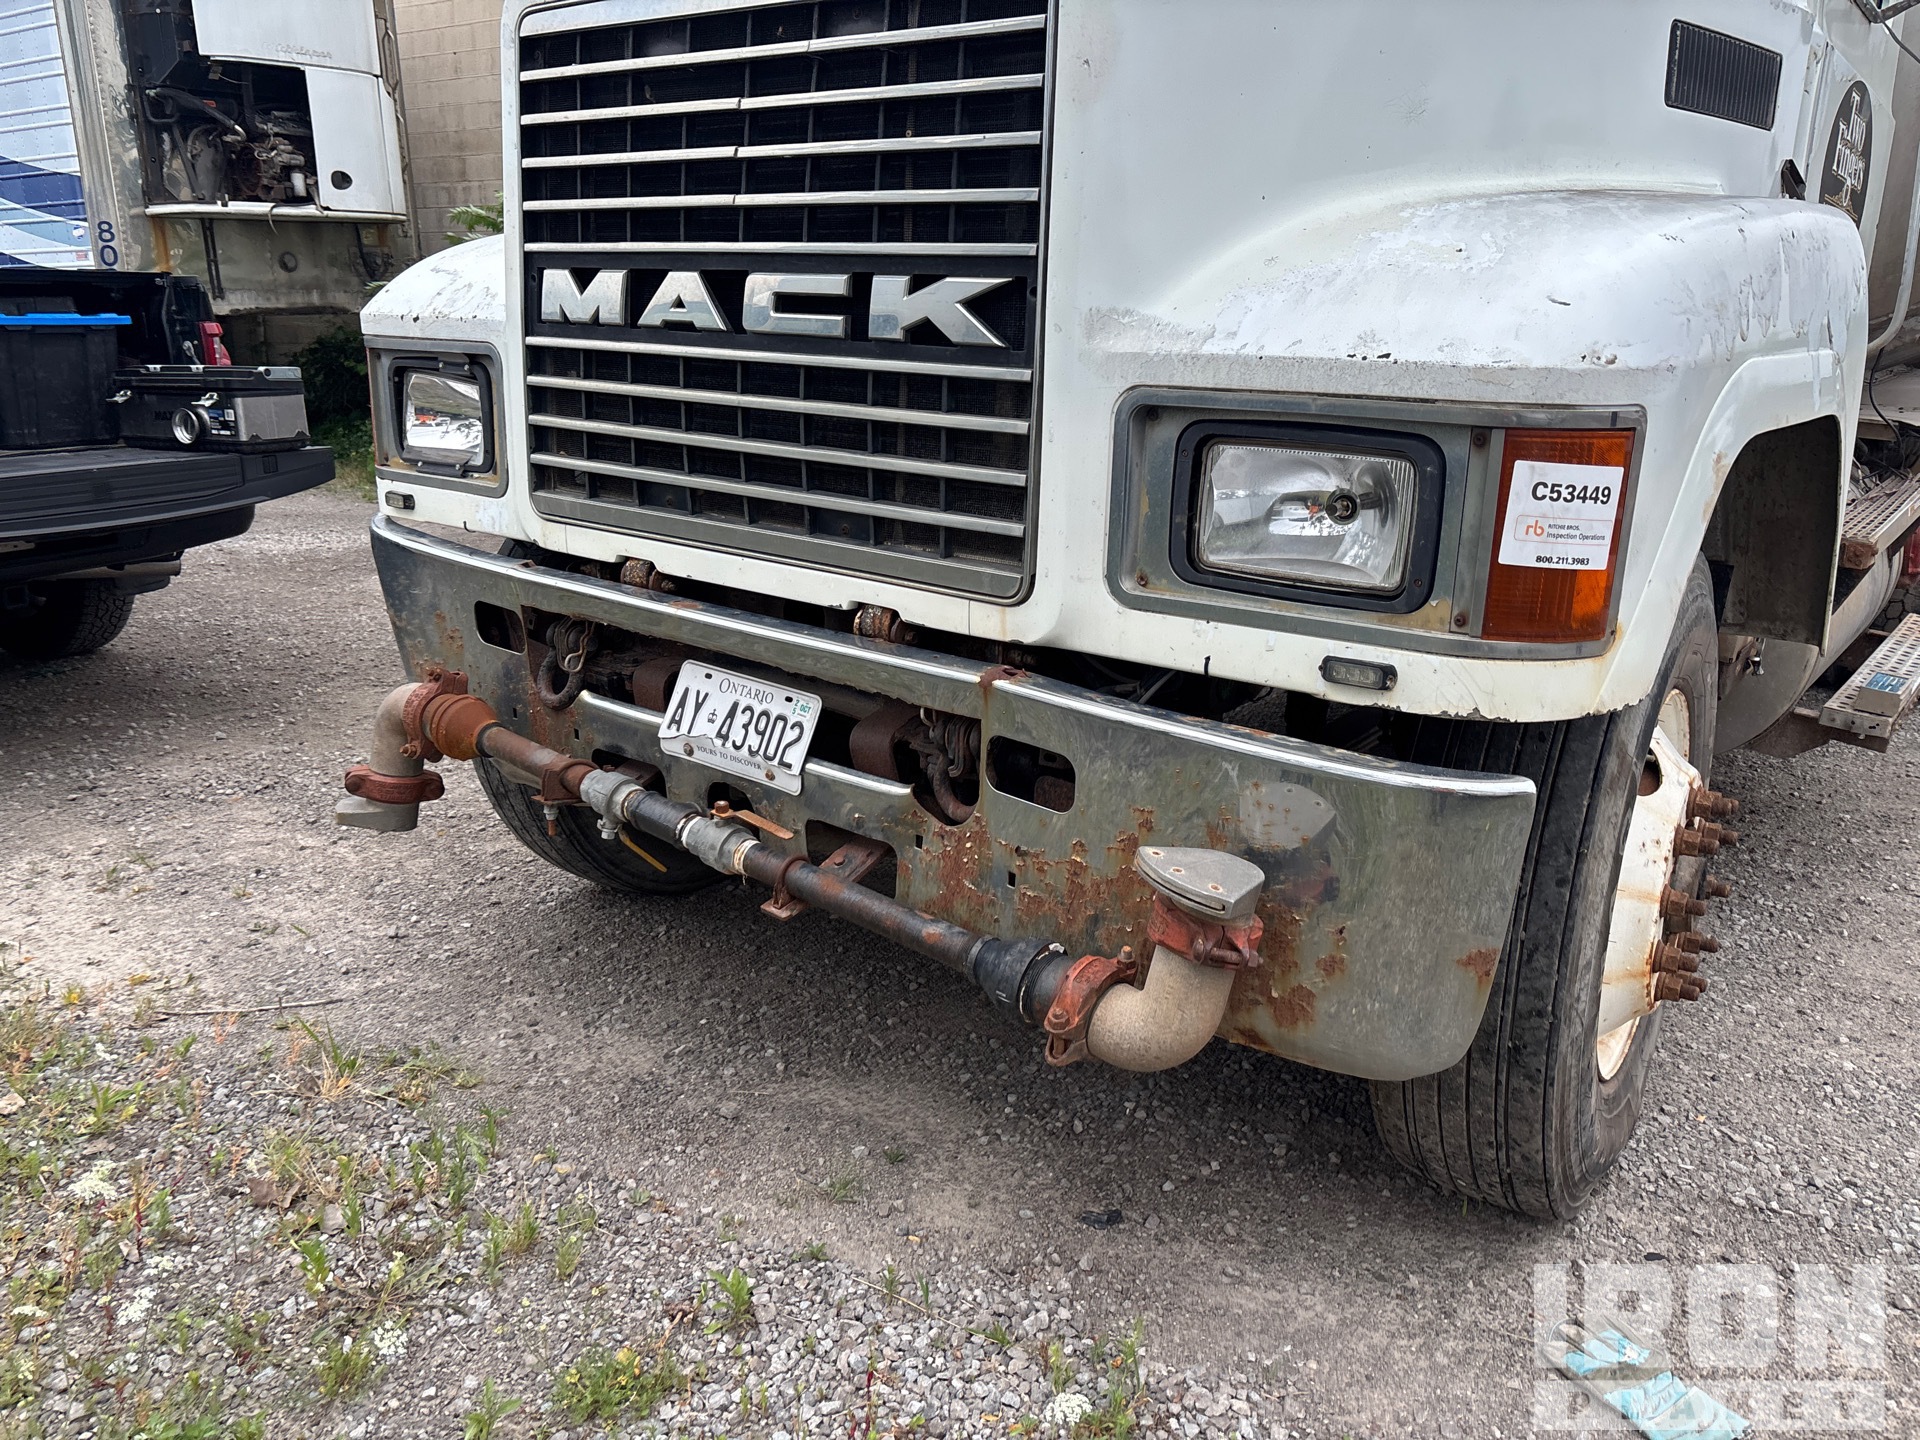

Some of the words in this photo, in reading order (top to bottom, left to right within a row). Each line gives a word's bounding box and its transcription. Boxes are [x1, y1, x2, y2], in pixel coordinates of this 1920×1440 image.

[541, 268, 1013, 349] MACK
[1531, 481, 1611, 504] C53449
[1525, 520, 1545, 537] rb
[1546, 531, 1578, 541] Inspection
[1578, 532, 1606, 542] Operations
[1547, 523, 1566, 531] RITCHIE
[1535, 555, 1590, 566] 800.211.3983
[719, 678, 775, 706] ONTARIO
[667, 687, 709, 734] AY
[715, 700, 804, 769] 43902
[696, 744, 718, 757] YOURS
[719, 751, 729, 760] TO
[729, 755, 762, 771] DISCOVER
